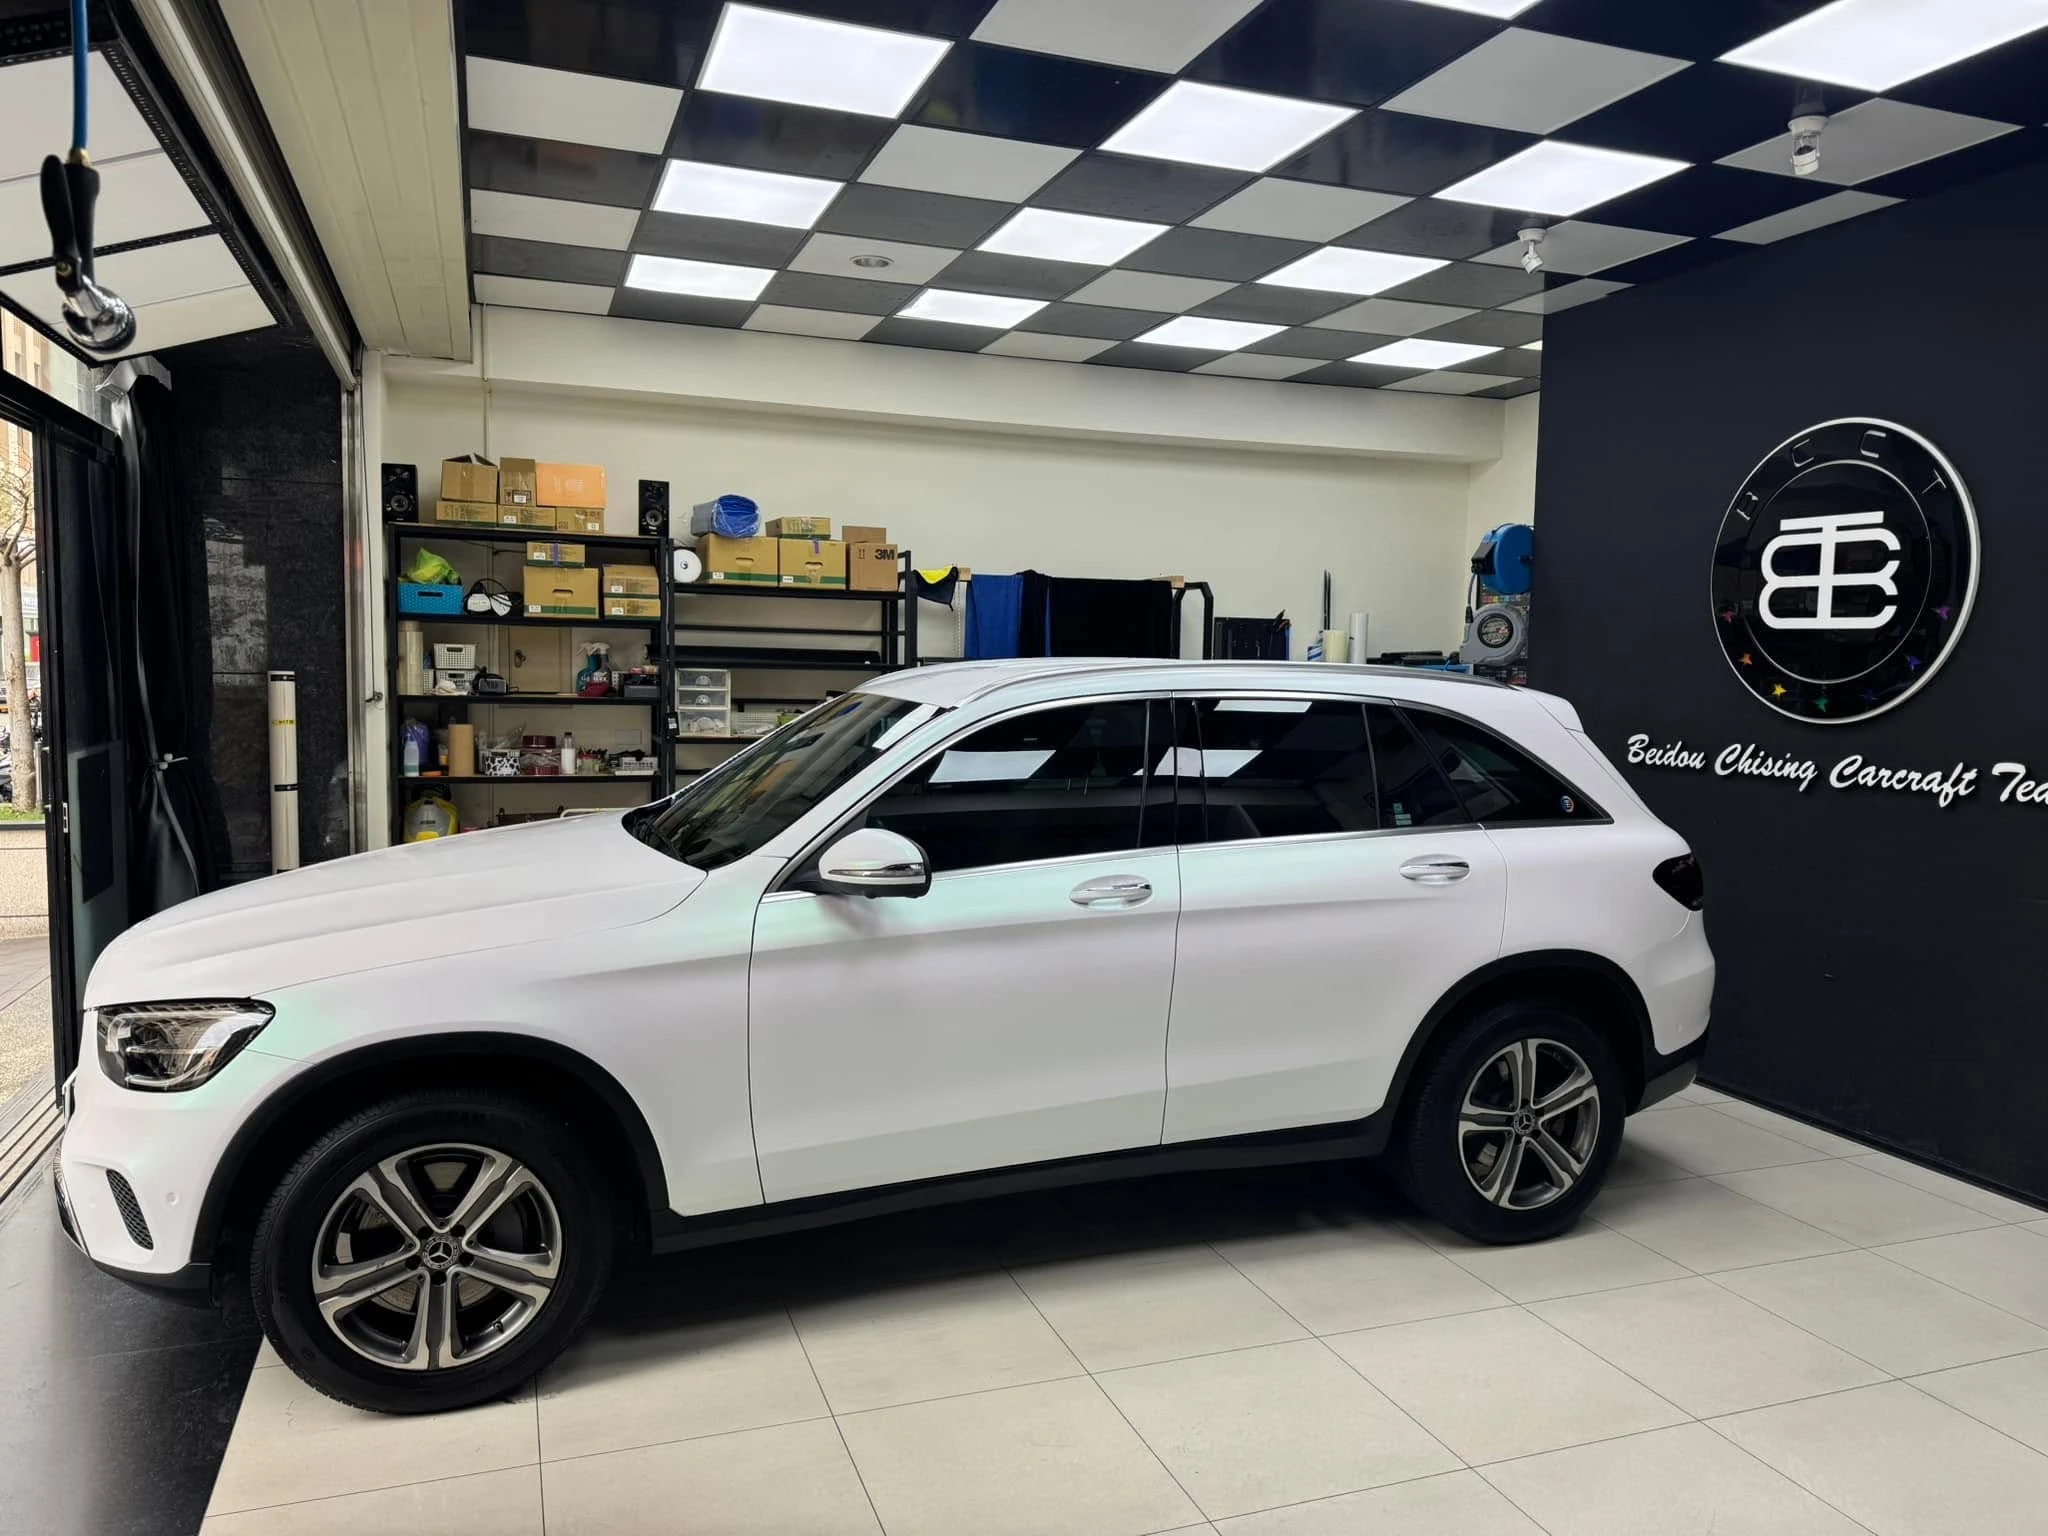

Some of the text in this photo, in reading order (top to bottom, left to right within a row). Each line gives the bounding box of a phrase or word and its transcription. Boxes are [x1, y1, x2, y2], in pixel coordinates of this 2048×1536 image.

[874, 548, 895, 560] 3M
[1627, 733, 1705, 770] Beidou
[1714, 743, 1818, 792] Chising
[1829, 754, 1979, 808] Carcraft
